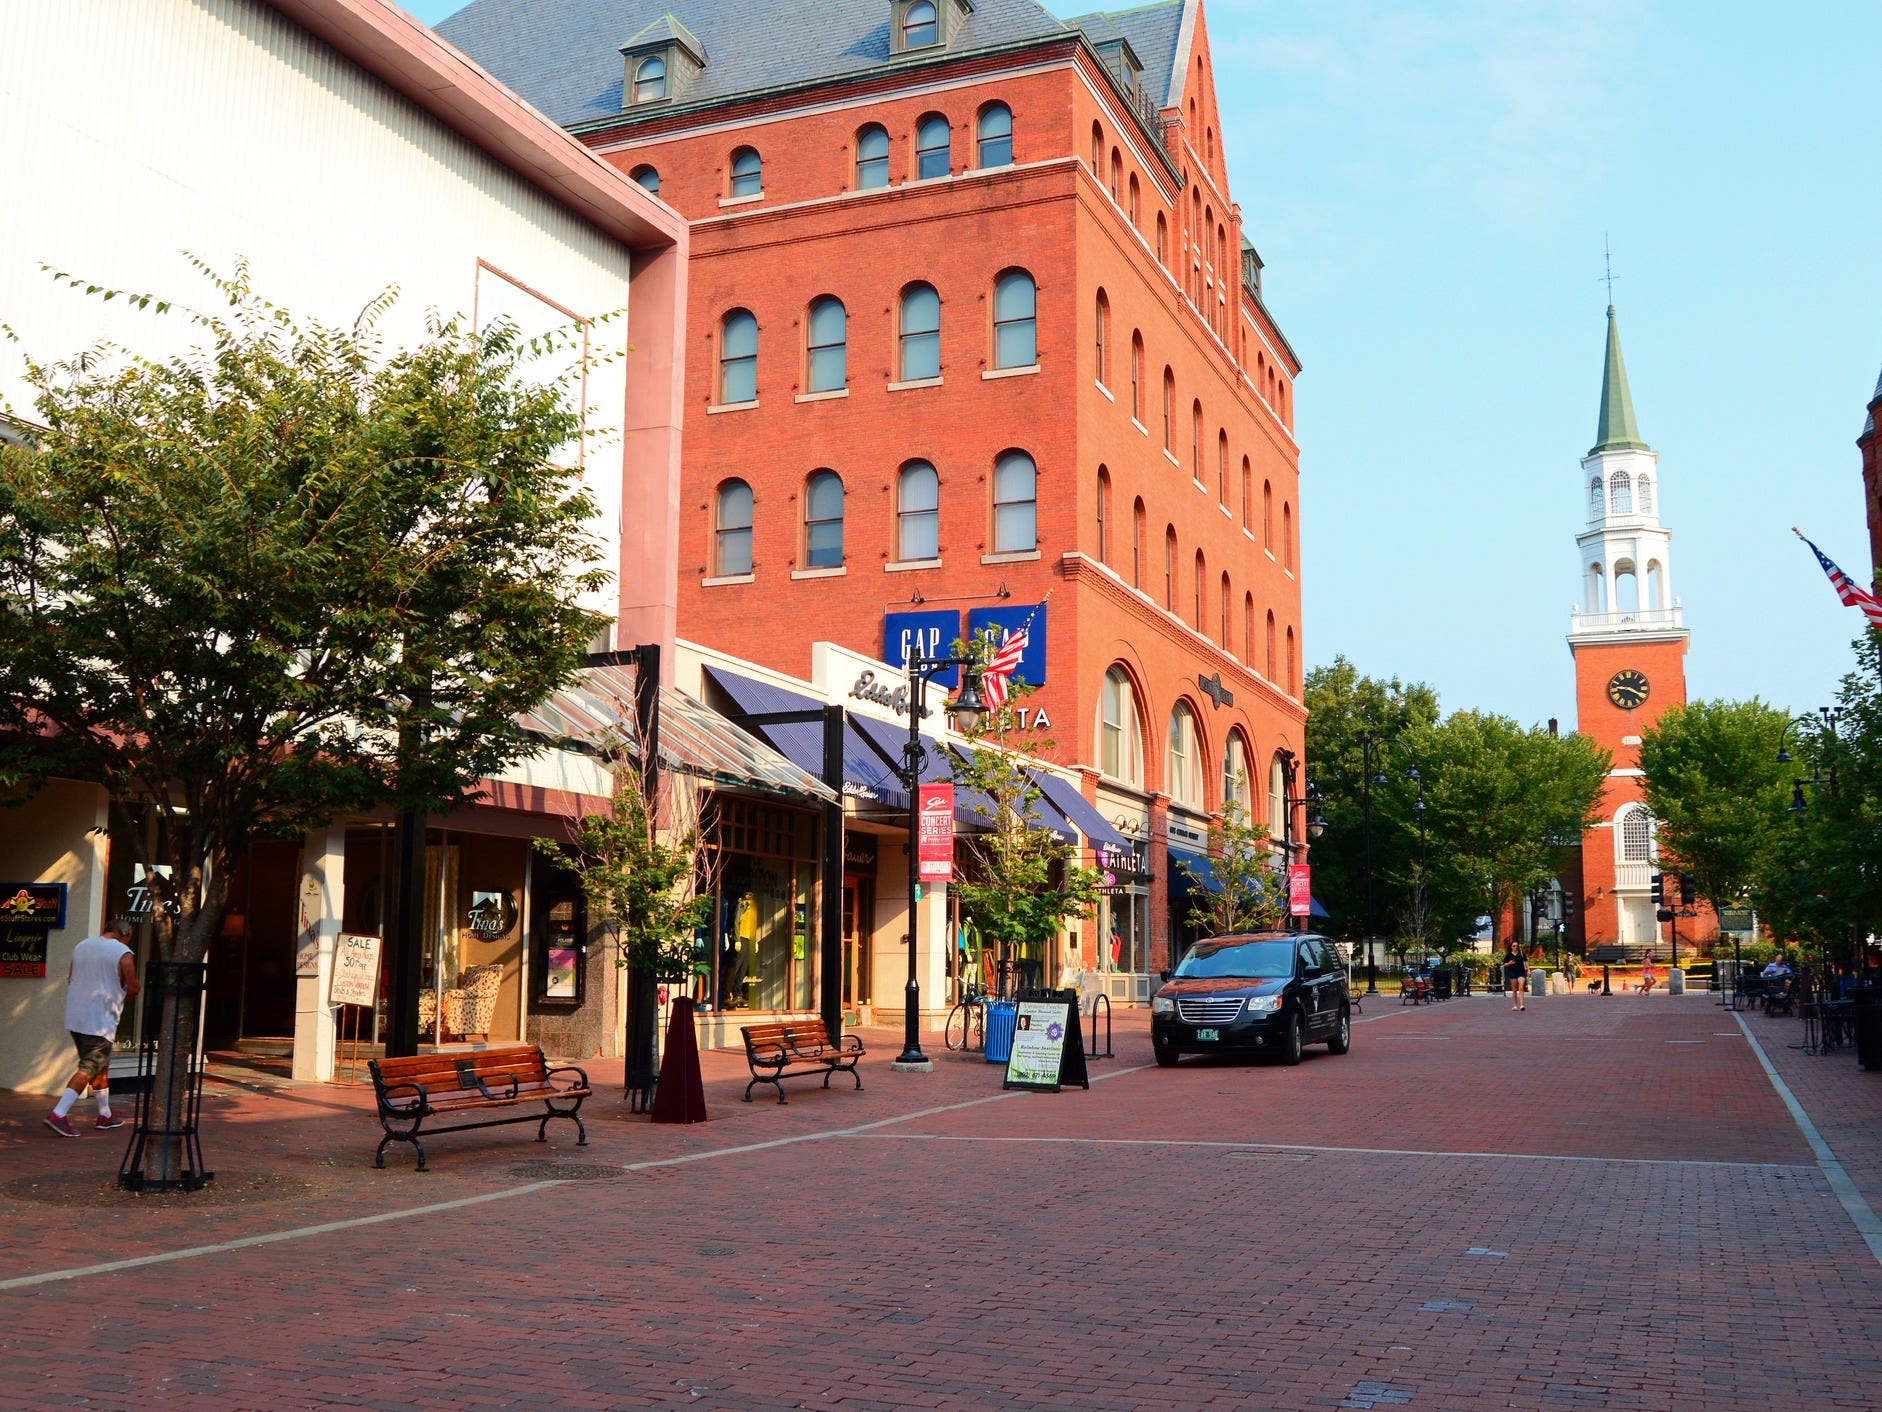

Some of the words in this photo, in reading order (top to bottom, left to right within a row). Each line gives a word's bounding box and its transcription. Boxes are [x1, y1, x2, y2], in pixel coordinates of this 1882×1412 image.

[901, 627, 940, 660] GAP
[921, 815, 952, 827] CONCERT
[921, 826, 952, 835] SERIES
[1109, 852, 1147, 873] ATHLETA
[467, 908, 504, 931] Tina's
[347, 936, 372, 950] SALE
[2, 952, 19, 961] Club
[21, 953, 43, 962] Wear
[3, 963, 39, 975] SALE
